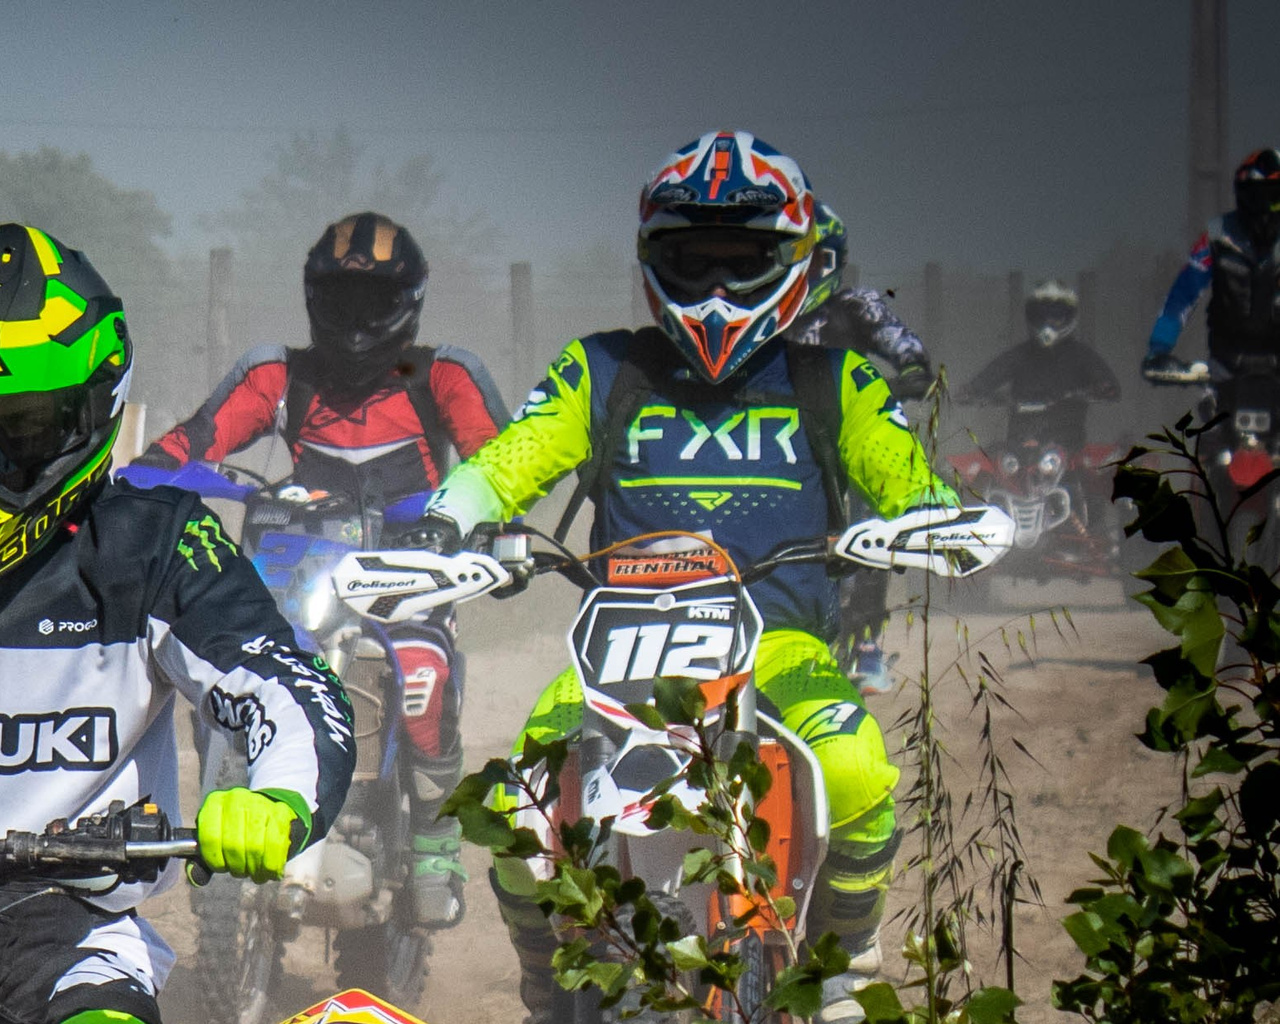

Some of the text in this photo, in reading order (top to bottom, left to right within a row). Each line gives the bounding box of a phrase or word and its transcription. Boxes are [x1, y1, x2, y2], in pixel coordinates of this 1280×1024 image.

[627, 405, 800, 464] FXR
[614, 559, 719, 576] RENTHAL
[347, 578, 416, 592] Polisport
[687, 606, 731, 621] KTM
[598, 623, 734, 685] 112
